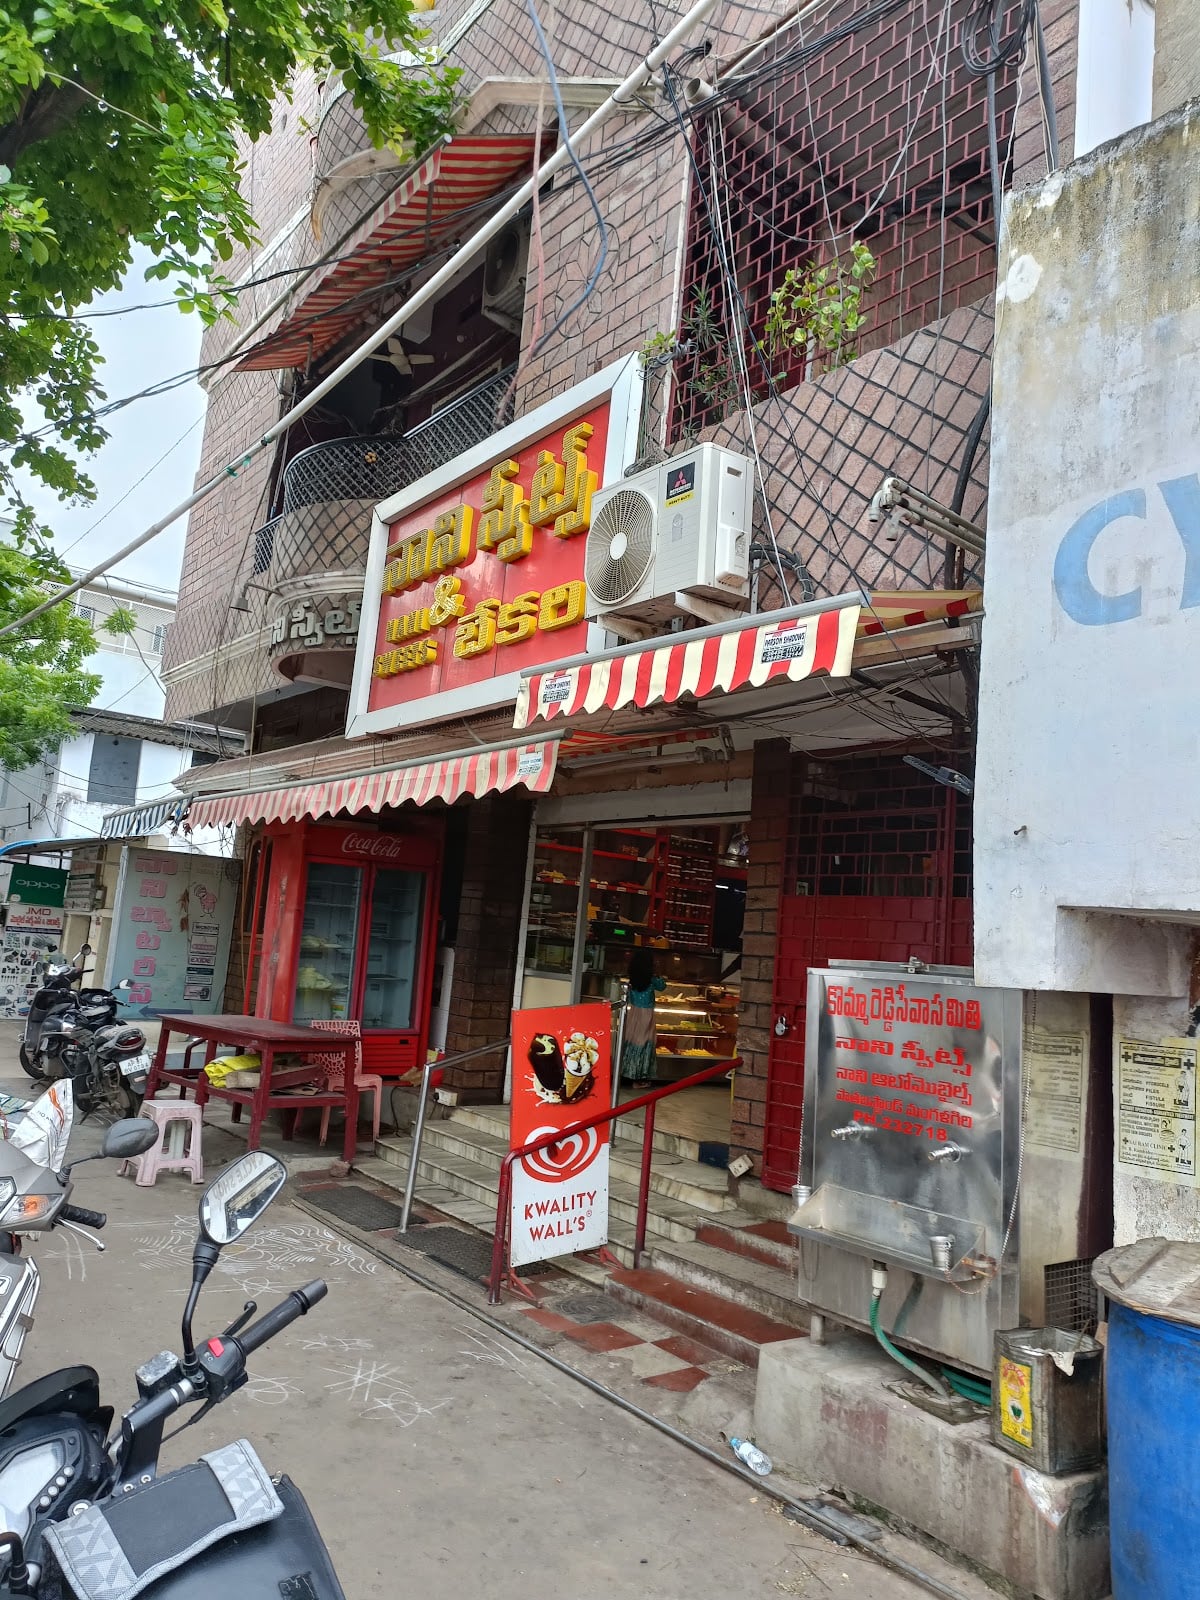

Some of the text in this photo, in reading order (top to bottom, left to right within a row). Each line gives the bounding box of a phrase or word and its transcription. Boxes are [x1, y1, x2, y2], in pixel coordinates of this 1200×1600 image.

[381, 421, 599, 595] నాని స్వీట్స్
[429, 575, 467, 627] &
[835, 1036, 894, 1056] నాని
[836, 1066, 868, 1084] నాని
[524, 1190, 597, 1221] KWALITY
[529, 1215, 586, 1242] WALL'S
